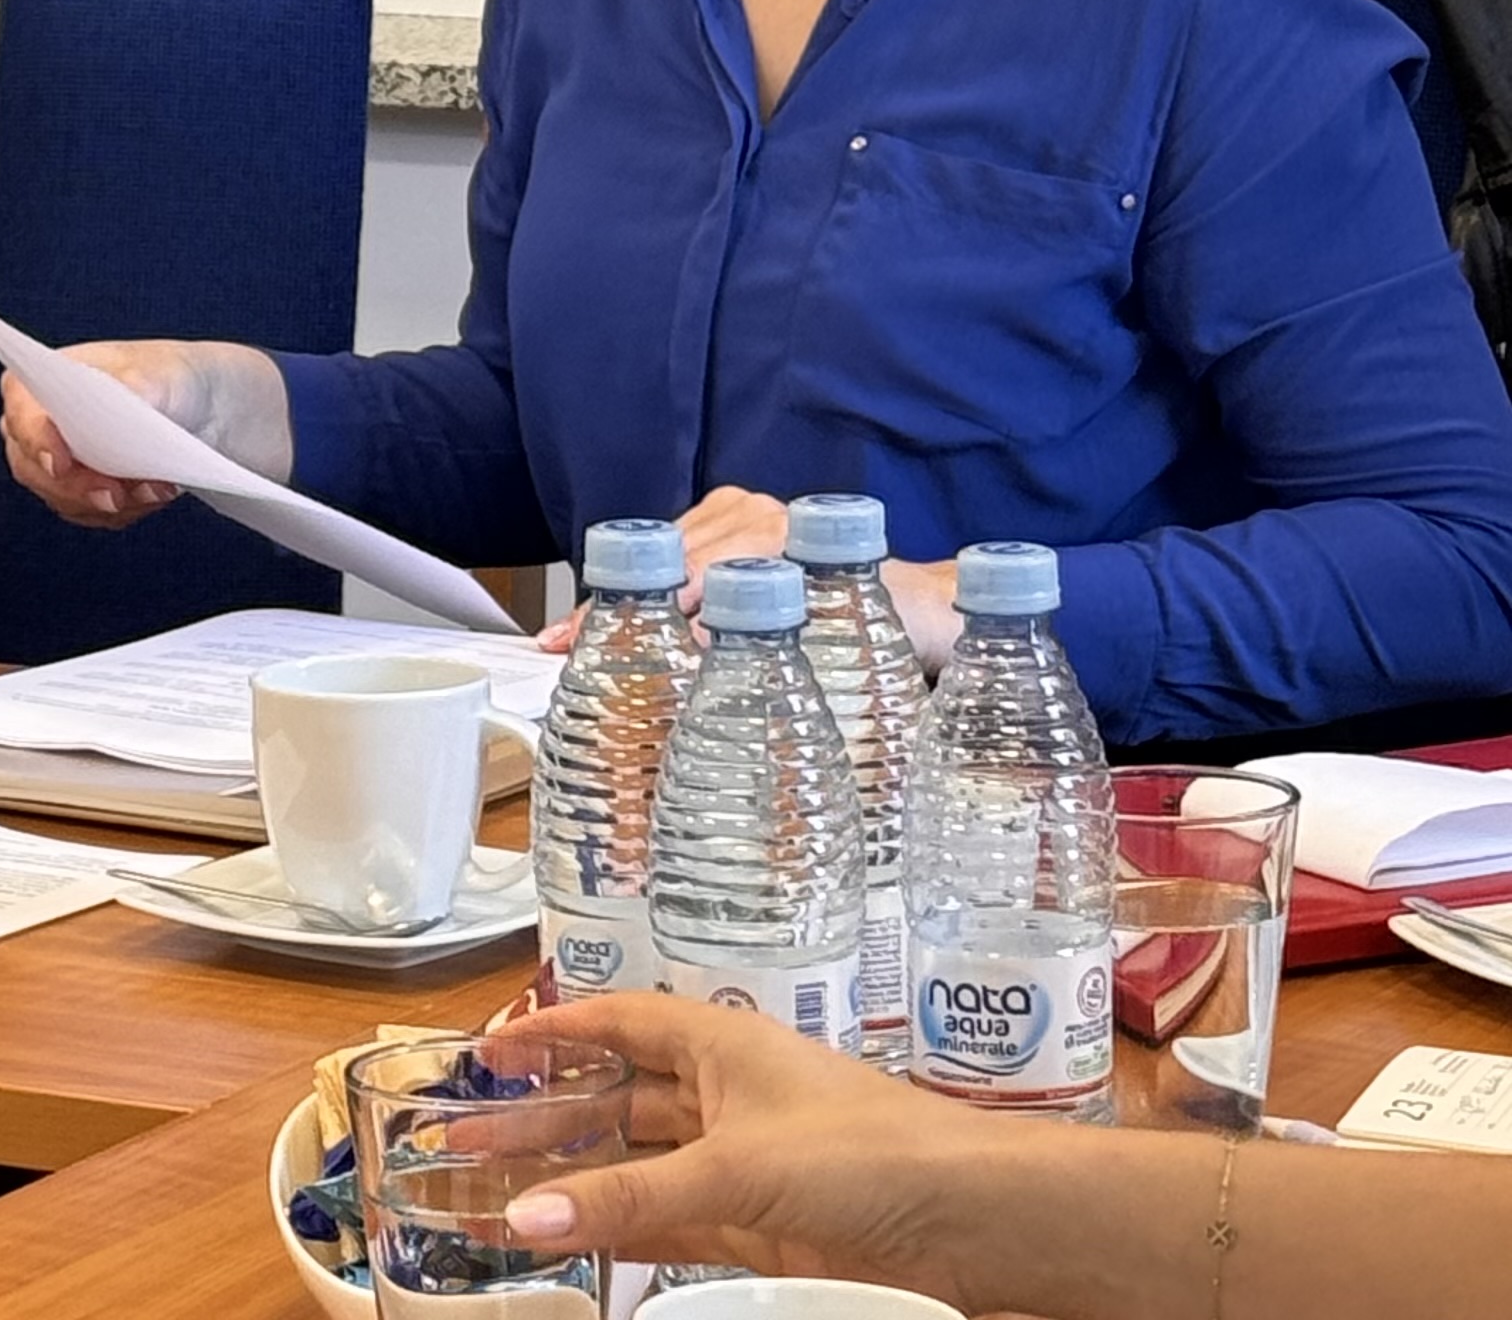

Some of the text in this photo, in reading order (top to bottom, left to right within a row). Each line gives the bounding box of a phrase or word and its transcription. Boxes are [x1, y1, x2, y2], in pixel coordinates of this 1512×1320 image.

[928, 978, 1032, 1015] nata
[944, 1015, 1010, 1039] aqua
[938, 1035, 1019, 1057] minerale
[1383, 1099, 1433, 1121] 23
